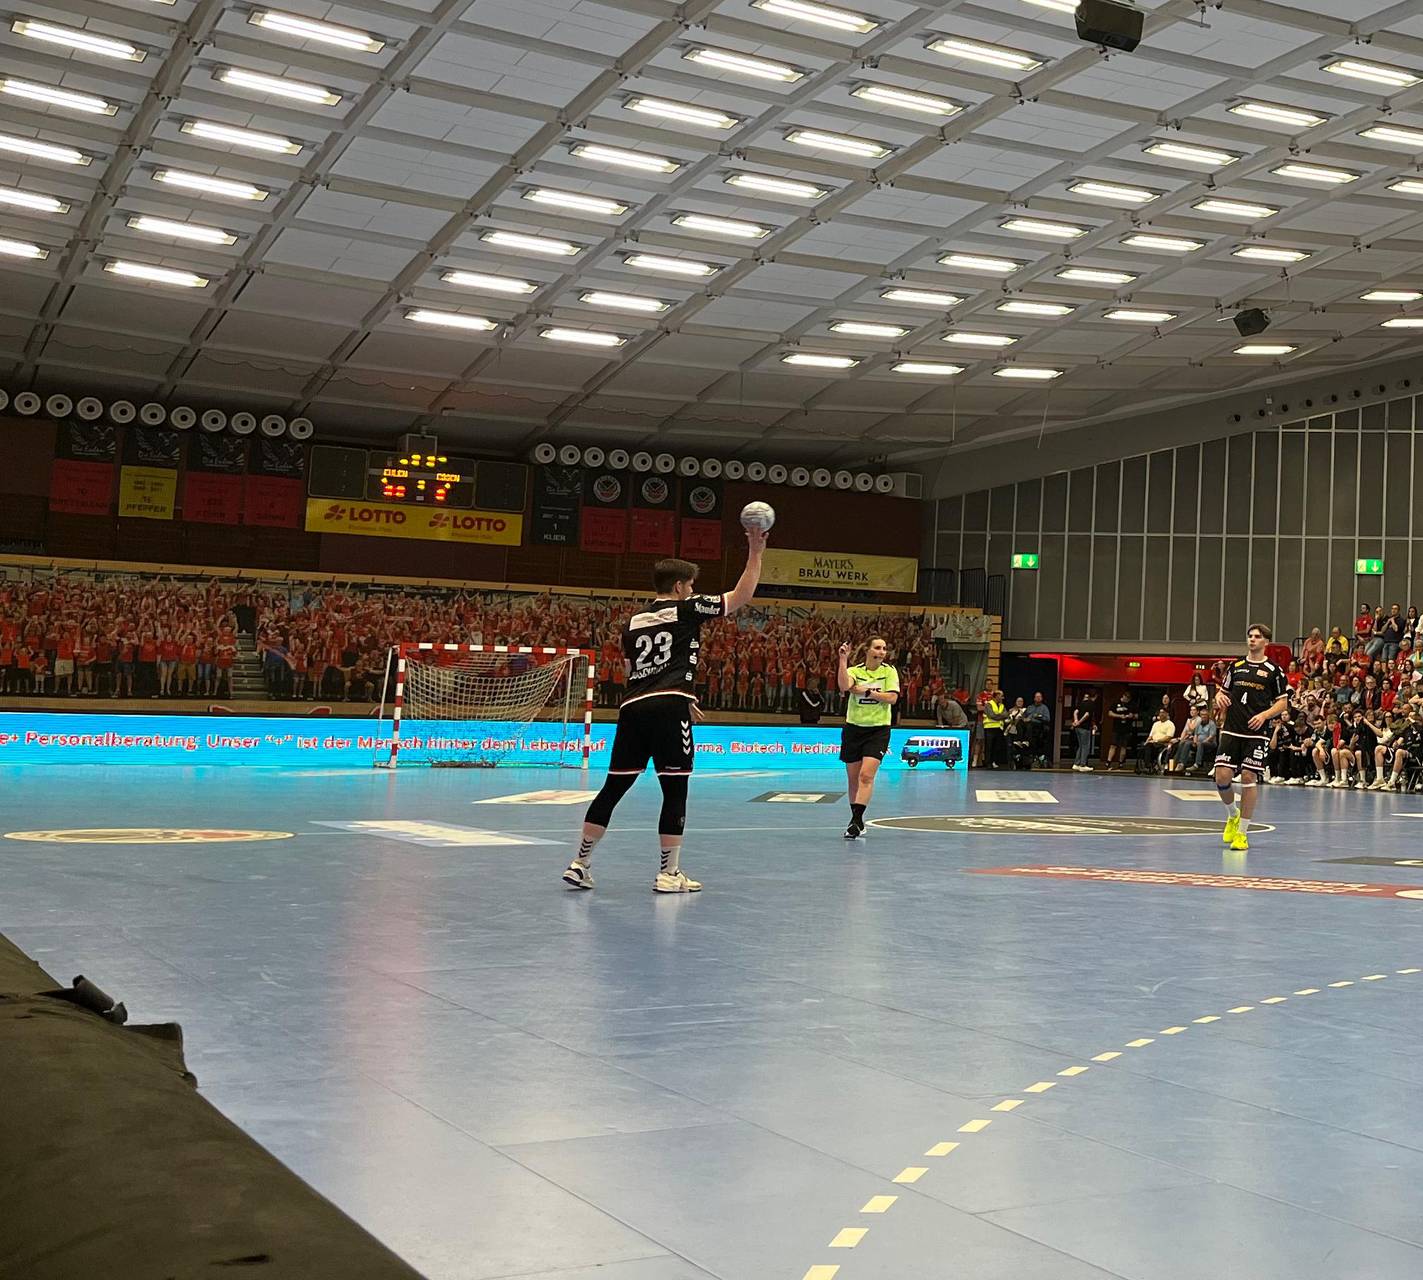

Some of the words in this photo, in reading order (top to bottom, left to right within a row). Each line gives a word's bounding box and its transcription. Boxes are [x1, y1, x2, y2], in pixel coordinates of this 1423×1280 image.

[349, 508, 406, 524] LOTTO
[452, 516, 506, 532] LOTTO
[799, 568, 830, 580] BRAU
[837, 571, 870, 582] WERK
[635, 631, 673, 671] 23
[1240, 691, 1248, 705] 4
[207, 735, 260, 749] Unser
[298, 736, 317, 749] ist
[324, 736, 352, 750] der
[428, 736, 476, 750] hinter
[482, 737, 517, 751] dem
